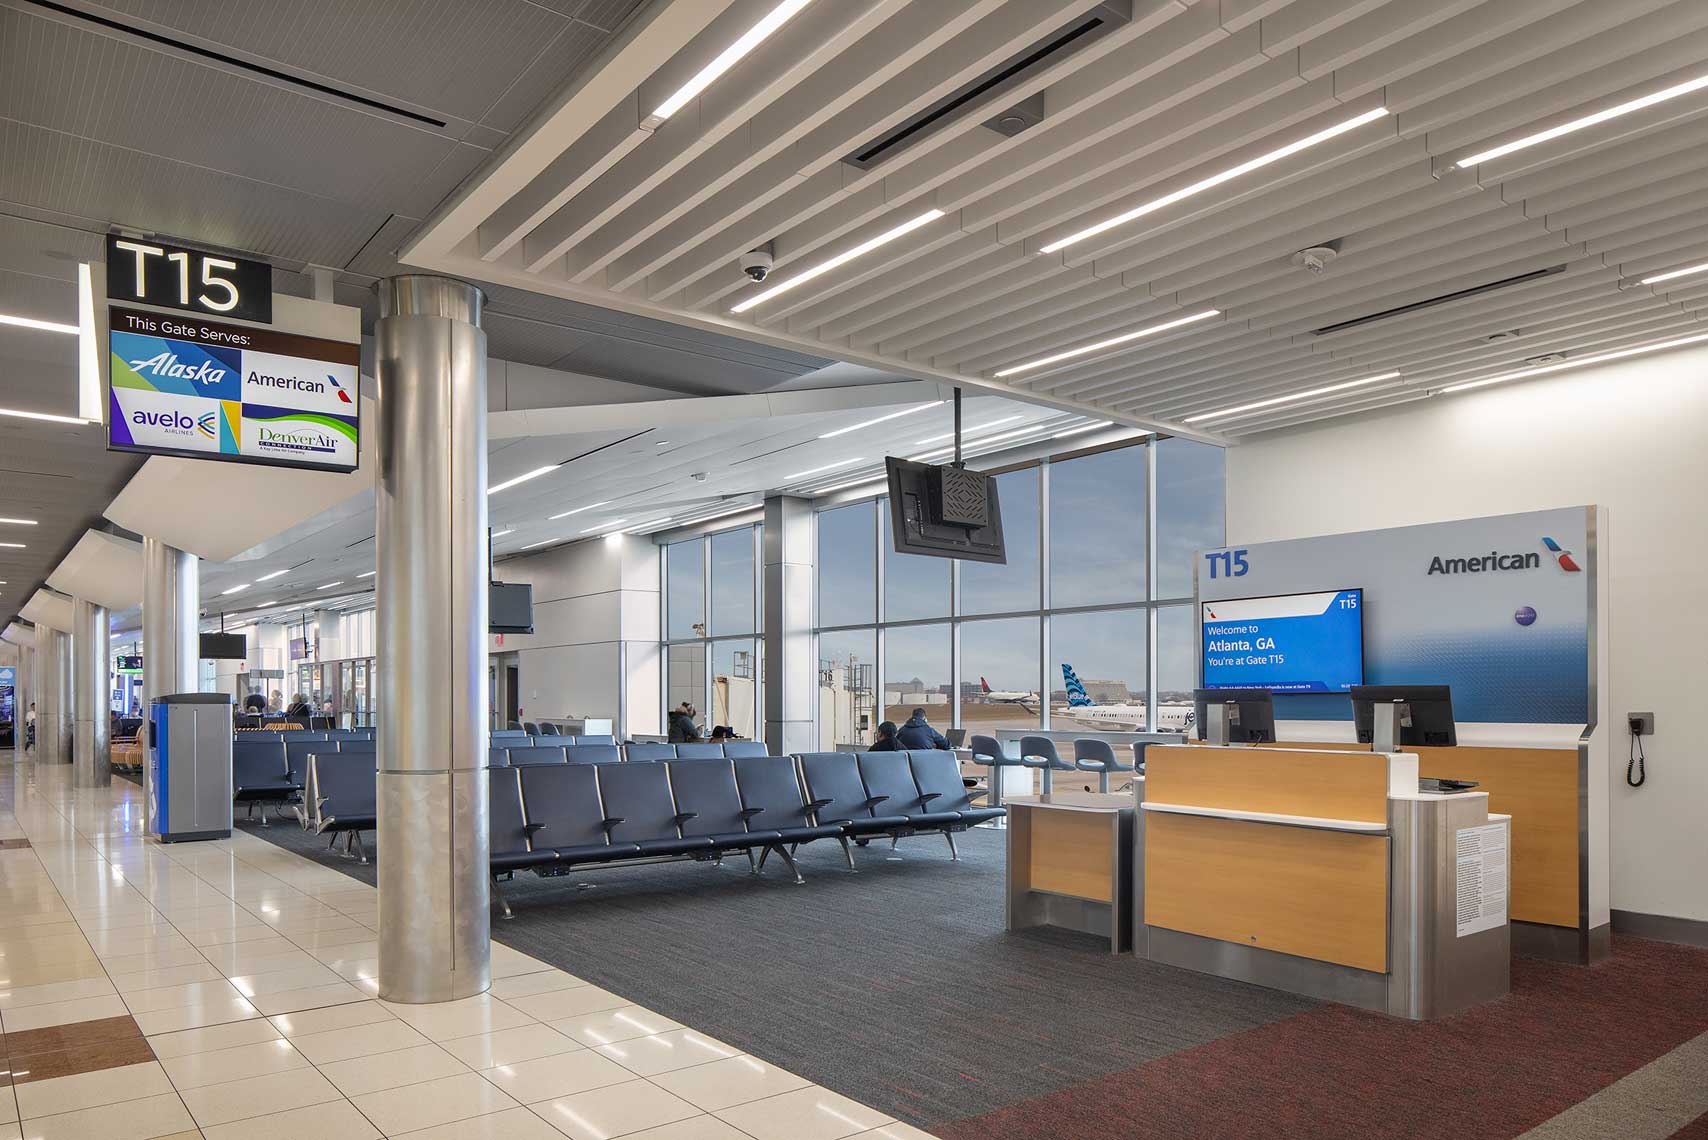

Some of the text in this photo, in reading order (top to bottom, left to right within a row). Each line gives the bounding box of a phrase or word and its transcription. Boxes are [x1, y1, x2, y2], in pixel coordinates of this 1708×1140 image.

[116, 240, 239, 312] T15
[126, 315, 251, 345] This Gate Serves:
[129, 352, 226, 385] Alaska
[247, 371, 324, 394] American
[132, 410, 194, 429] avelo
[164, 428, 194, 437] AIRLINES
[1205, 549, 1249, 579] T15
[1427, 551, 1540, 576] American
[1339, 599, 1357, 609] T15
[1207, 624, 1259, 636] Welcome to
[1208, 637, 1276, 653] Atlanta, GA
[1208, 654, 1284, 666] You're at Gate T15
